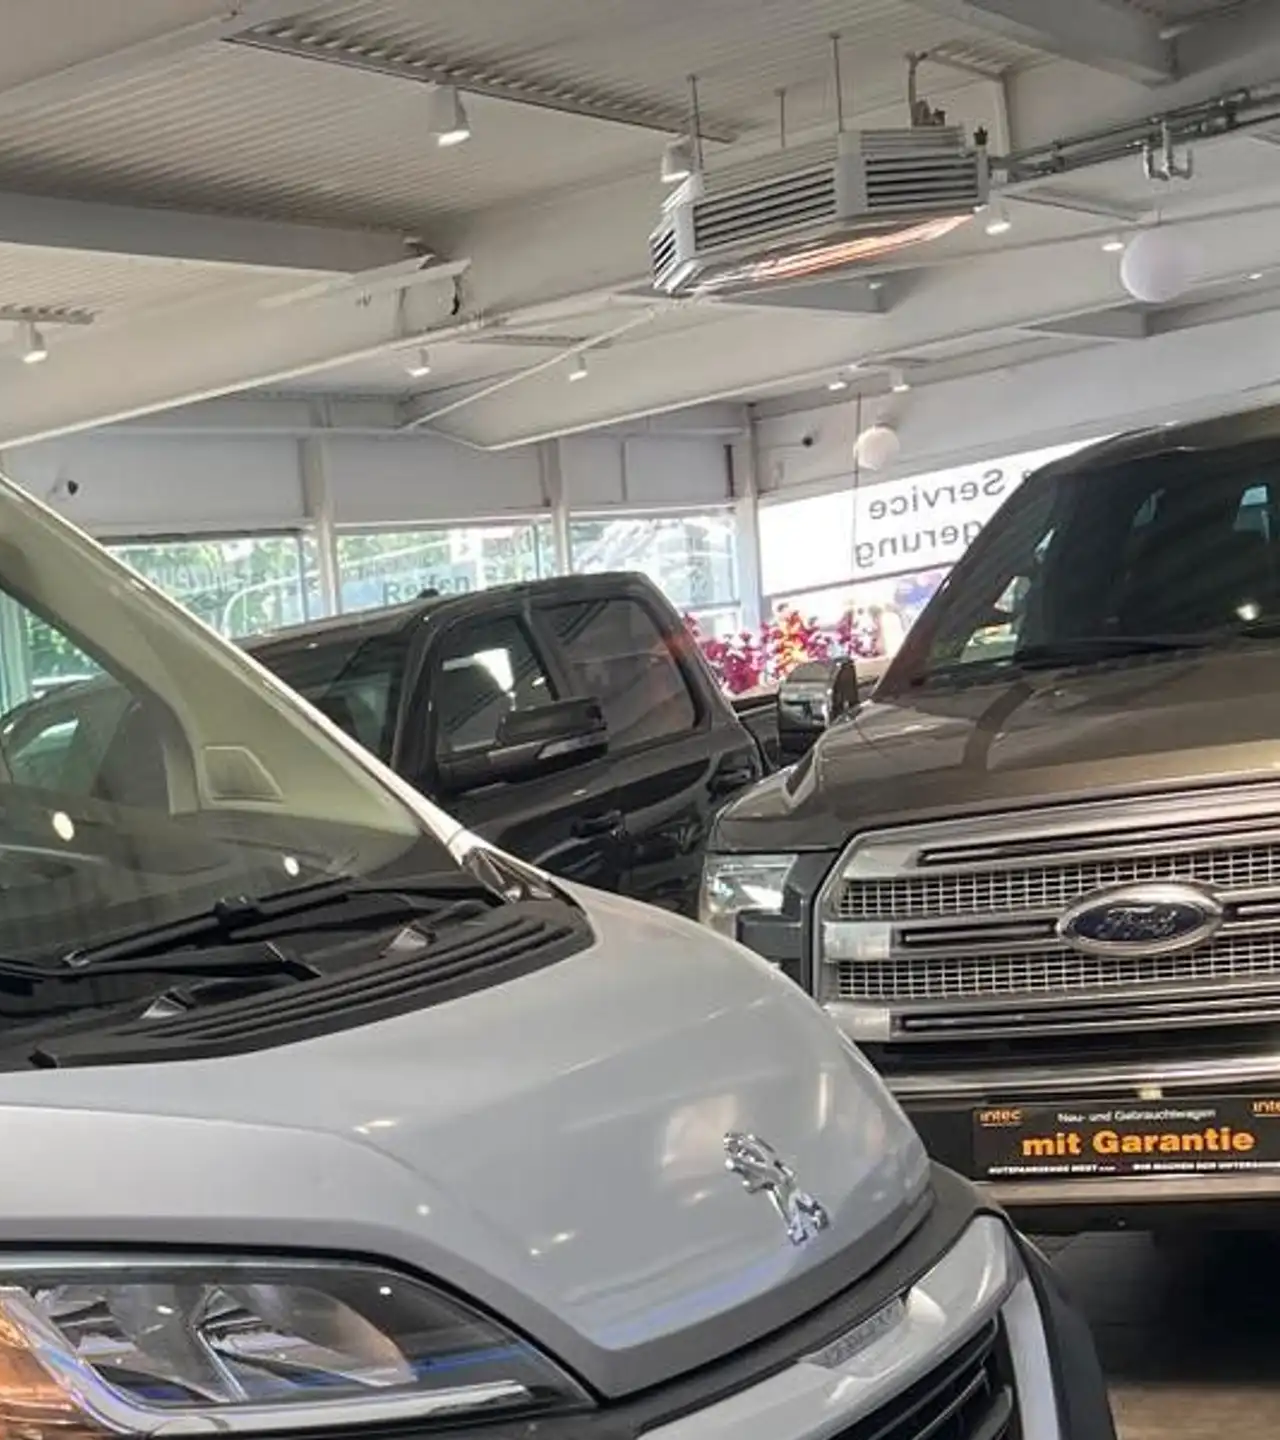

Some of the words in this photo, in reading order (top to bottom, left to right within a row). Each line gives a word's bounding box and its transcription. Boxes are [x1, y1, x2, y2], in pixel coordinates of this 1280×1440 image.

[1089, 1111, 1112, 1122] und
[1022, 1132, 1082, 1156] mit
[1092, 1126, 1256, 1154] Garantie
